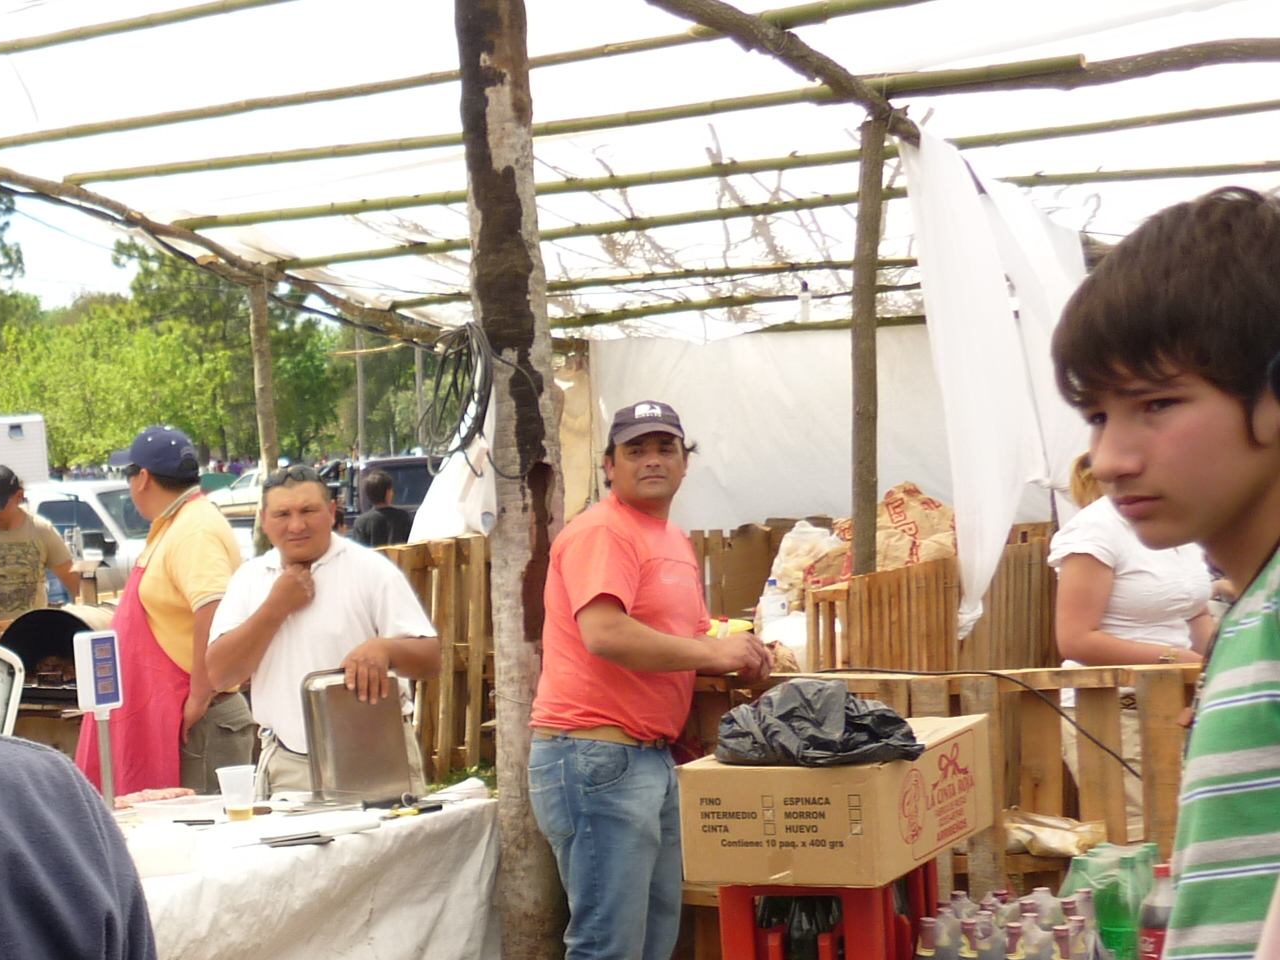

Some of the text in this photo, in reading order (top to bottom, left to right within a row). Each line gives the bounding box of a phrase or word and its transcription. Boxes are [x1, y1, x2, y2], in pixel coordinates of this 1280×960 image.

[699, 797, 722, 807] FINO
[783, 797, 831, 806] ESPINACA
[700, 811, 758, 820] INTERMEDIO
[784, 811, 826, 820] MORRON
[701, 825, 730, 834] CINTA
[785, 824, 819, 833] HUEVO
[720, 838, 763, 848] Contiene:
[779, 840, 799, 850] paq.
[809, 839, 827, 848] 400
[829, 840, 845, 850] grs
